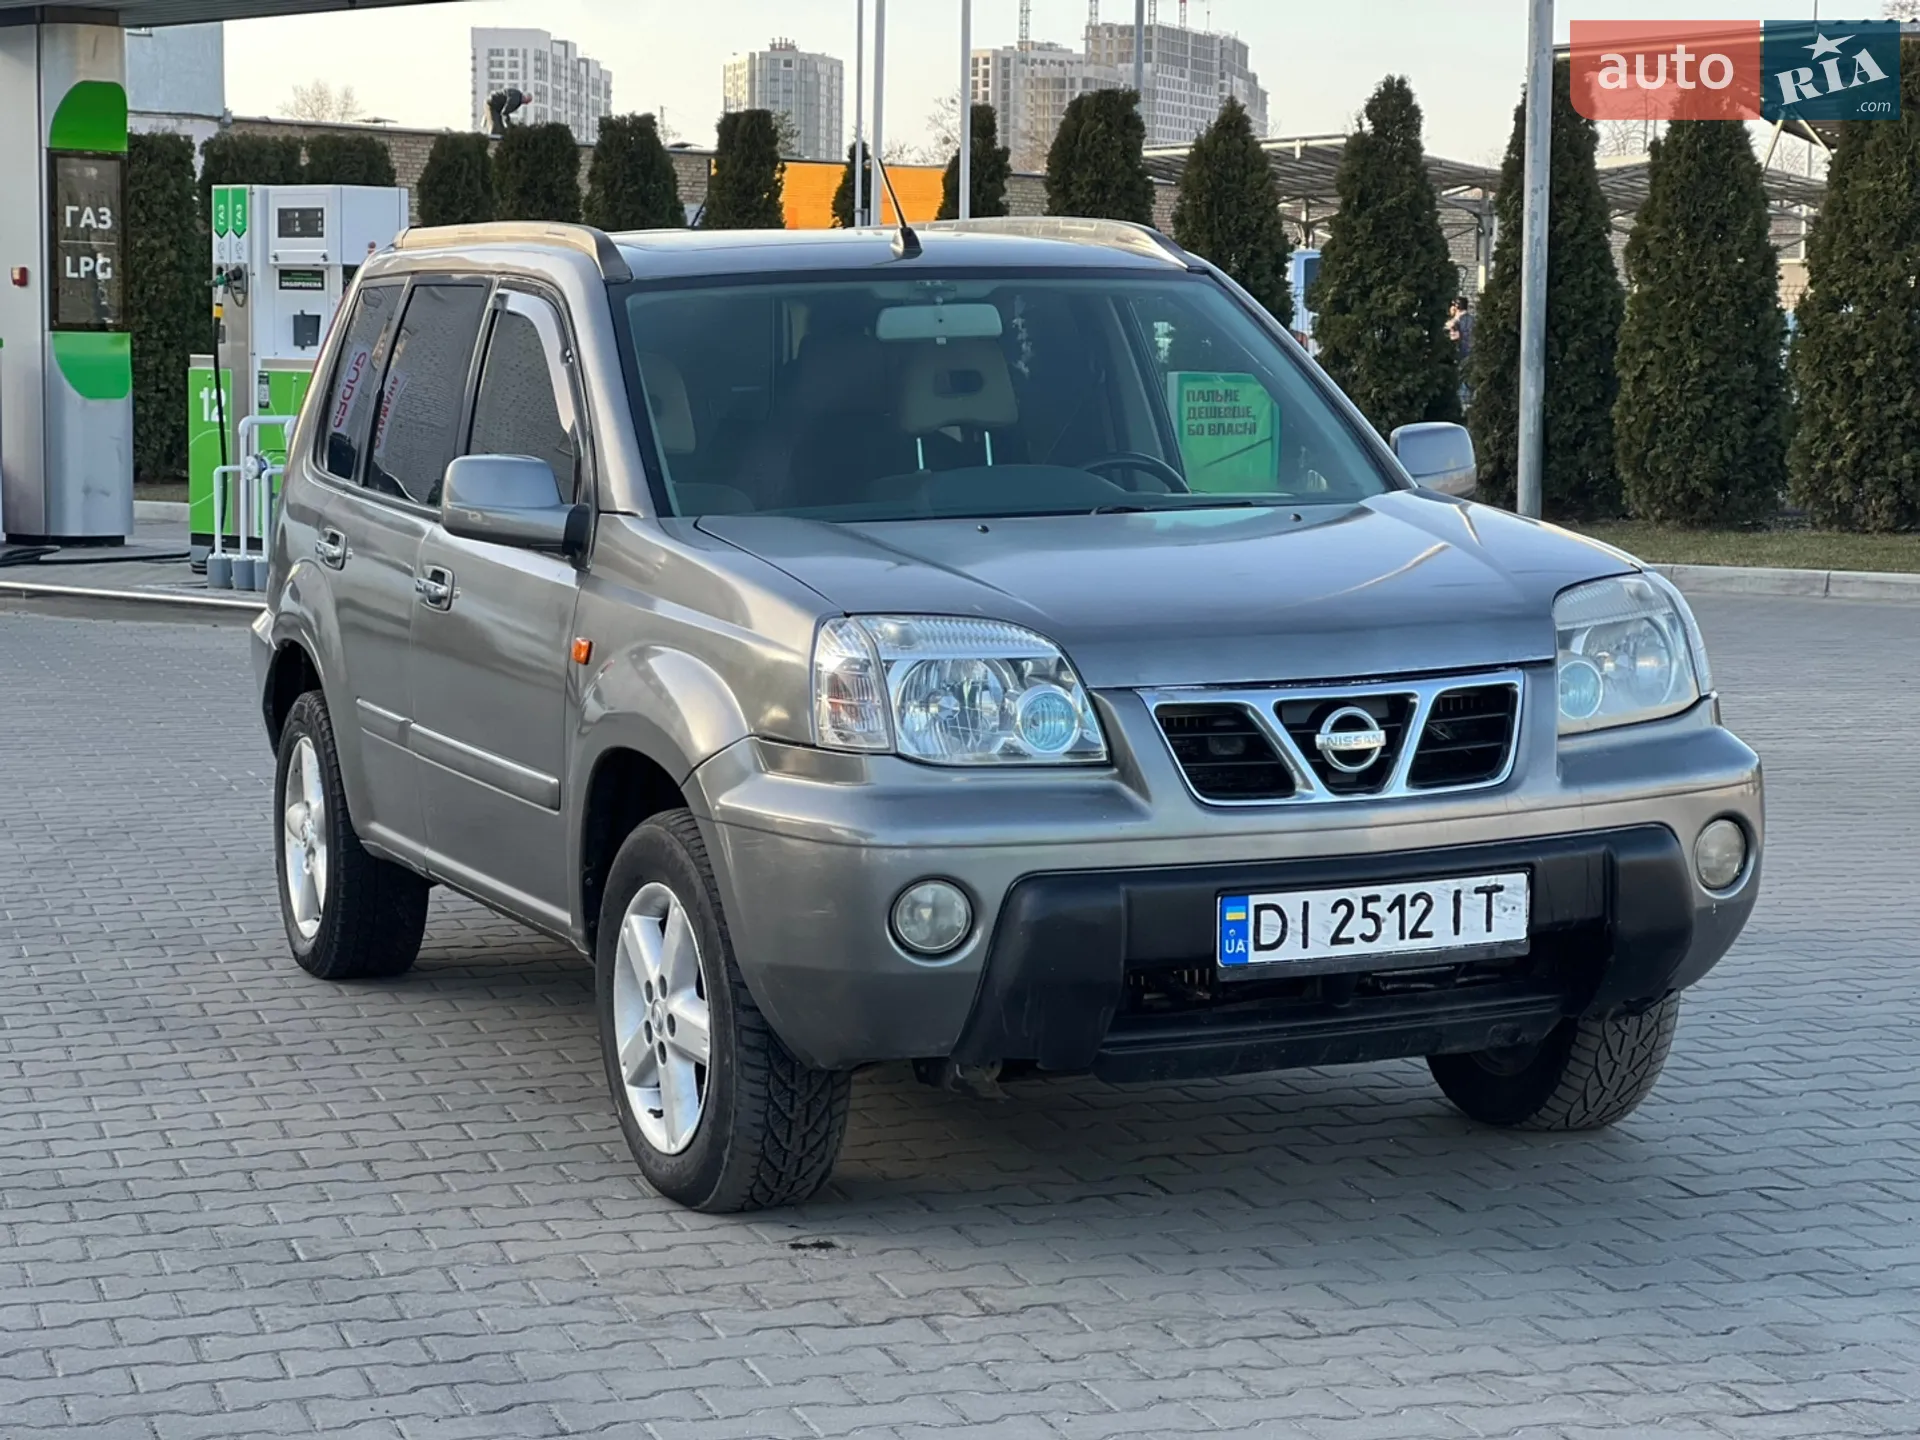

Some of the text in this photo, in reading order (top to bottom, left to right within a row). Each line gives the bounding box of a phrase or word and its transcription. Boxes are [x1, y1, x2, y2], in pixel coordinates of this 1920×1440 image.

[65, 205, 112, 229] ГАЗ
[218, 204, 226, 226] ГАЗ
[235, 204, 243, 226] ГАЗ
[65, 255, 112, 279] LPG
[199, 387, 226, 422] 12
[1186, 389, 1241, 403] ПАЛЬНЕ
[1187, 424, 1205, 436] БО
[1325, 734, 1381, 747] NISSAN
[1253, 884, 1504, 952] DI 2512 IT
[1225, 939, 1246, 955] UA
